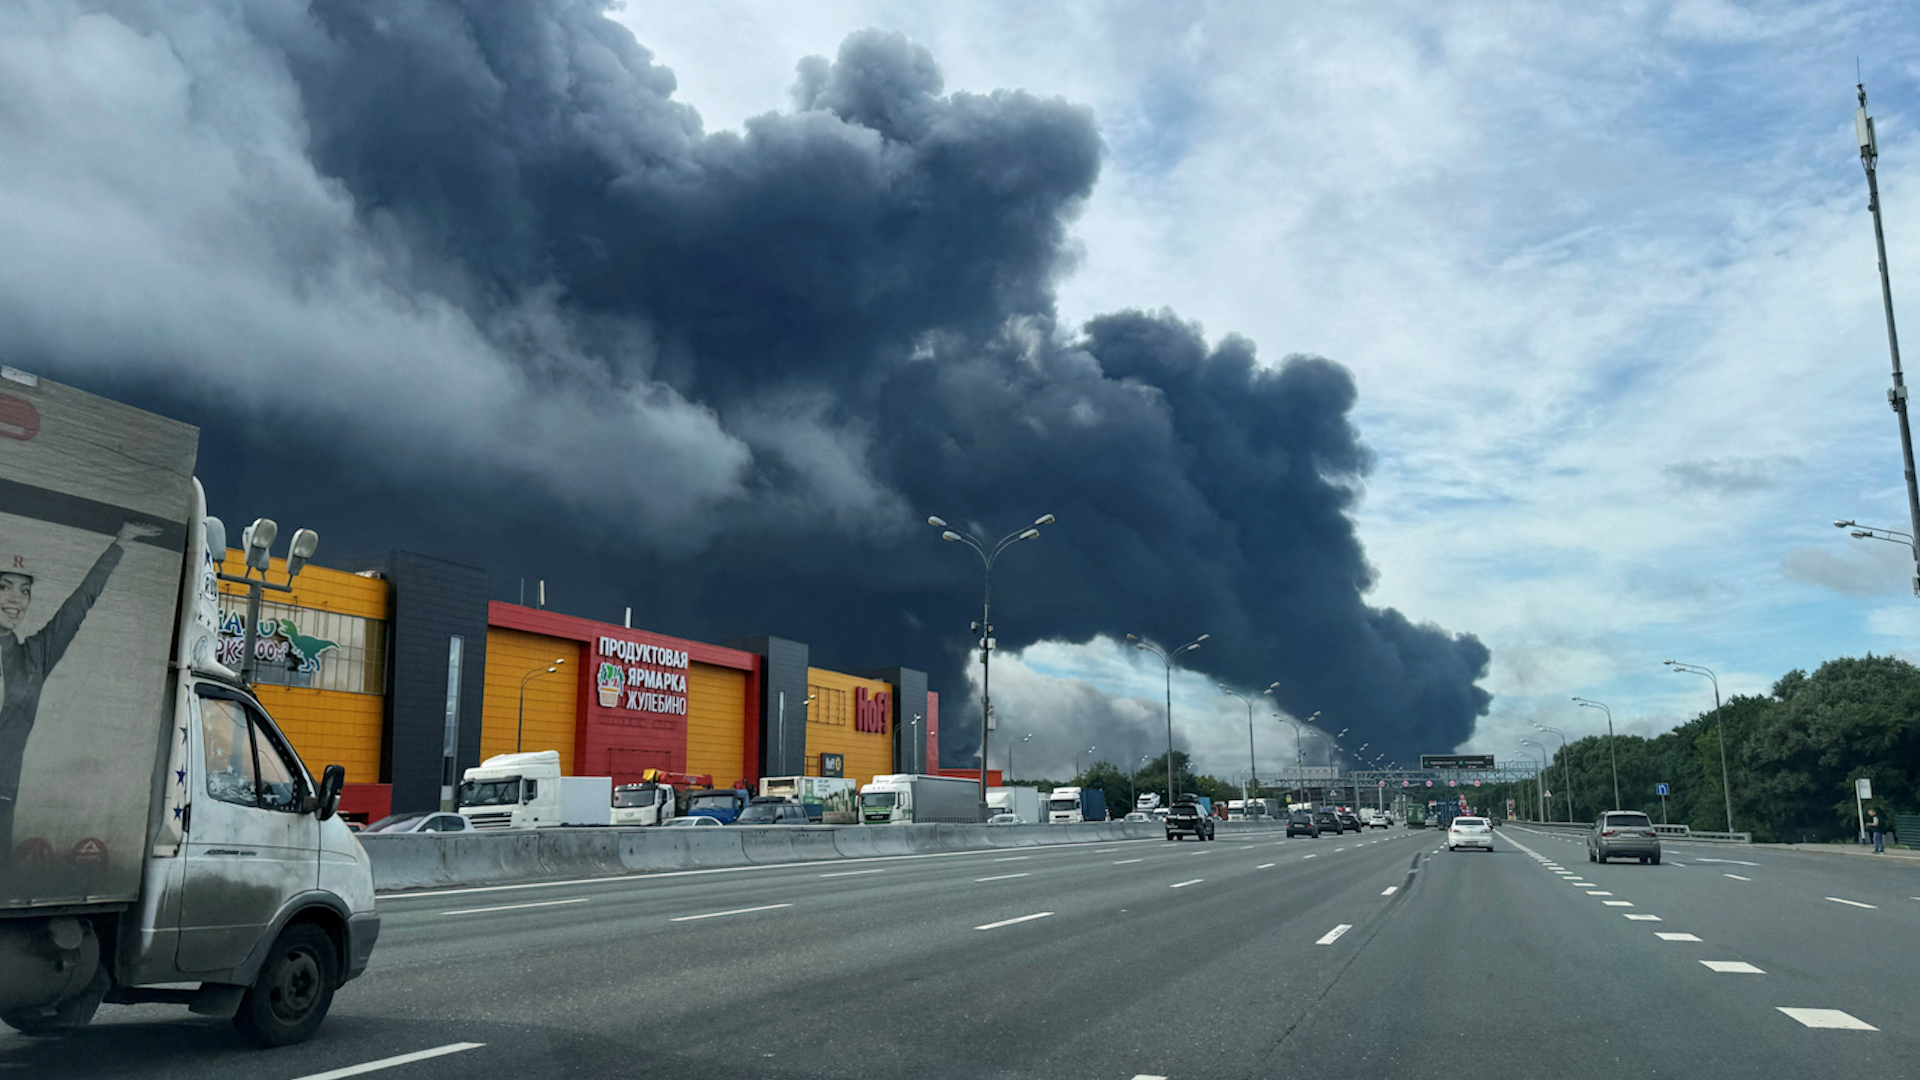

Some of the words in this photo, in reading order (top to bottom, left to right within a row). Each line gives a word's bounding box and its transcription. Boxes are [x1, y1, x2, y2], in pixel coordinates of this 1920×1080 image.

[599, 636, 688, 669] ПРОДУКТОВАЯ
[627, 667, 686, 693] ЯРМАРКА
[626, 690, 686, 716] ЖУЛЕБИНО
